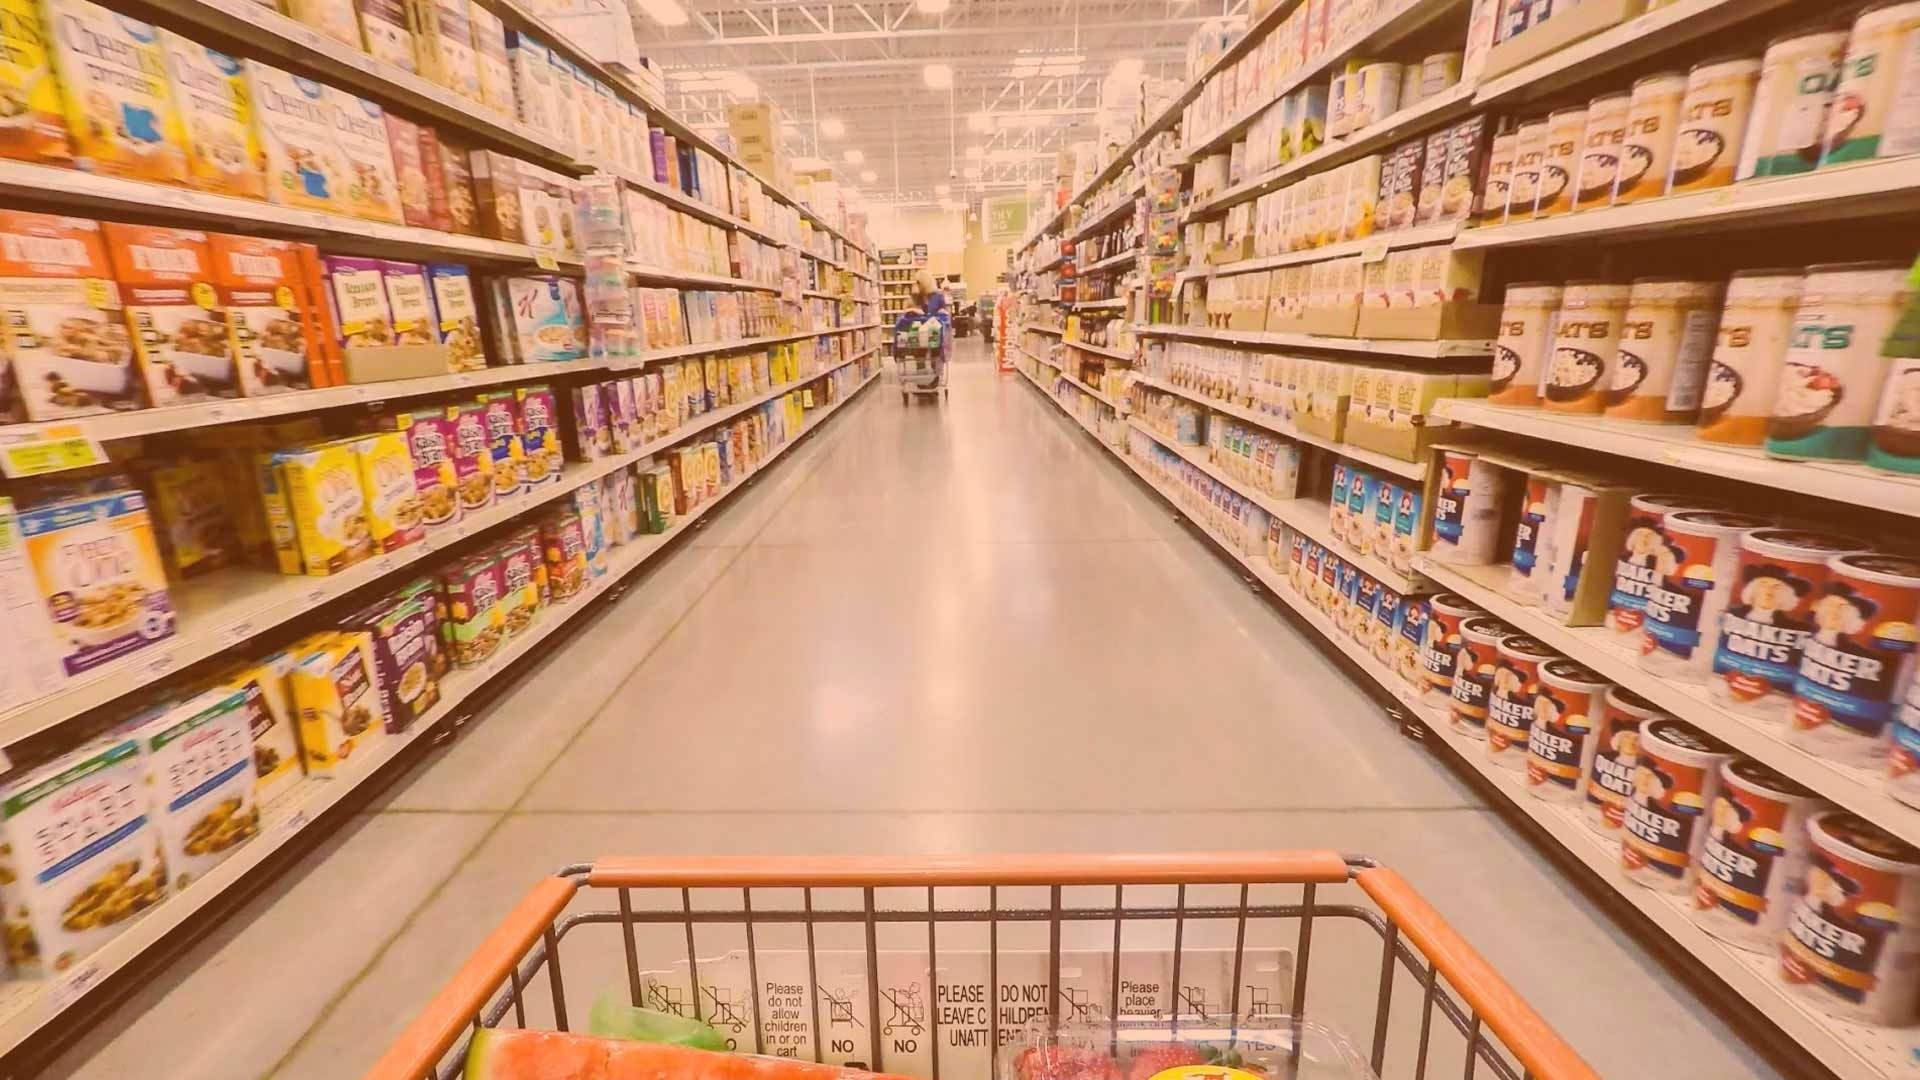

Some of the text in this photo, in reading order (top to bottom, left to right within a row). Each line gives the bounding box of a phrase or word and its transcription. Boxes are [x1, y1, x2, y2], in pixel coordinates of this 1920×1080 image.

[766, 983, 804, 995] Please
[1121, 981, 1160, 993] Please
[938, 984, 1048, 1003] PLEASE DO NOT
[768, 996, 803, 1007] do not
[1125, 994, 1155, 1007] place
[771, 1008, 800, 1020] allow
[937, 1007, 974, 1025] LEAVE
[764, 1020, 807, 1032] children
[725, 1038, 737, 1051] O
[766, 1034, 807, 1045] in or on
[777, 1046, 798, 1057] cart
[832, 1039, 854, 1053] NO
[894, 1039, 917, 1053] NO
